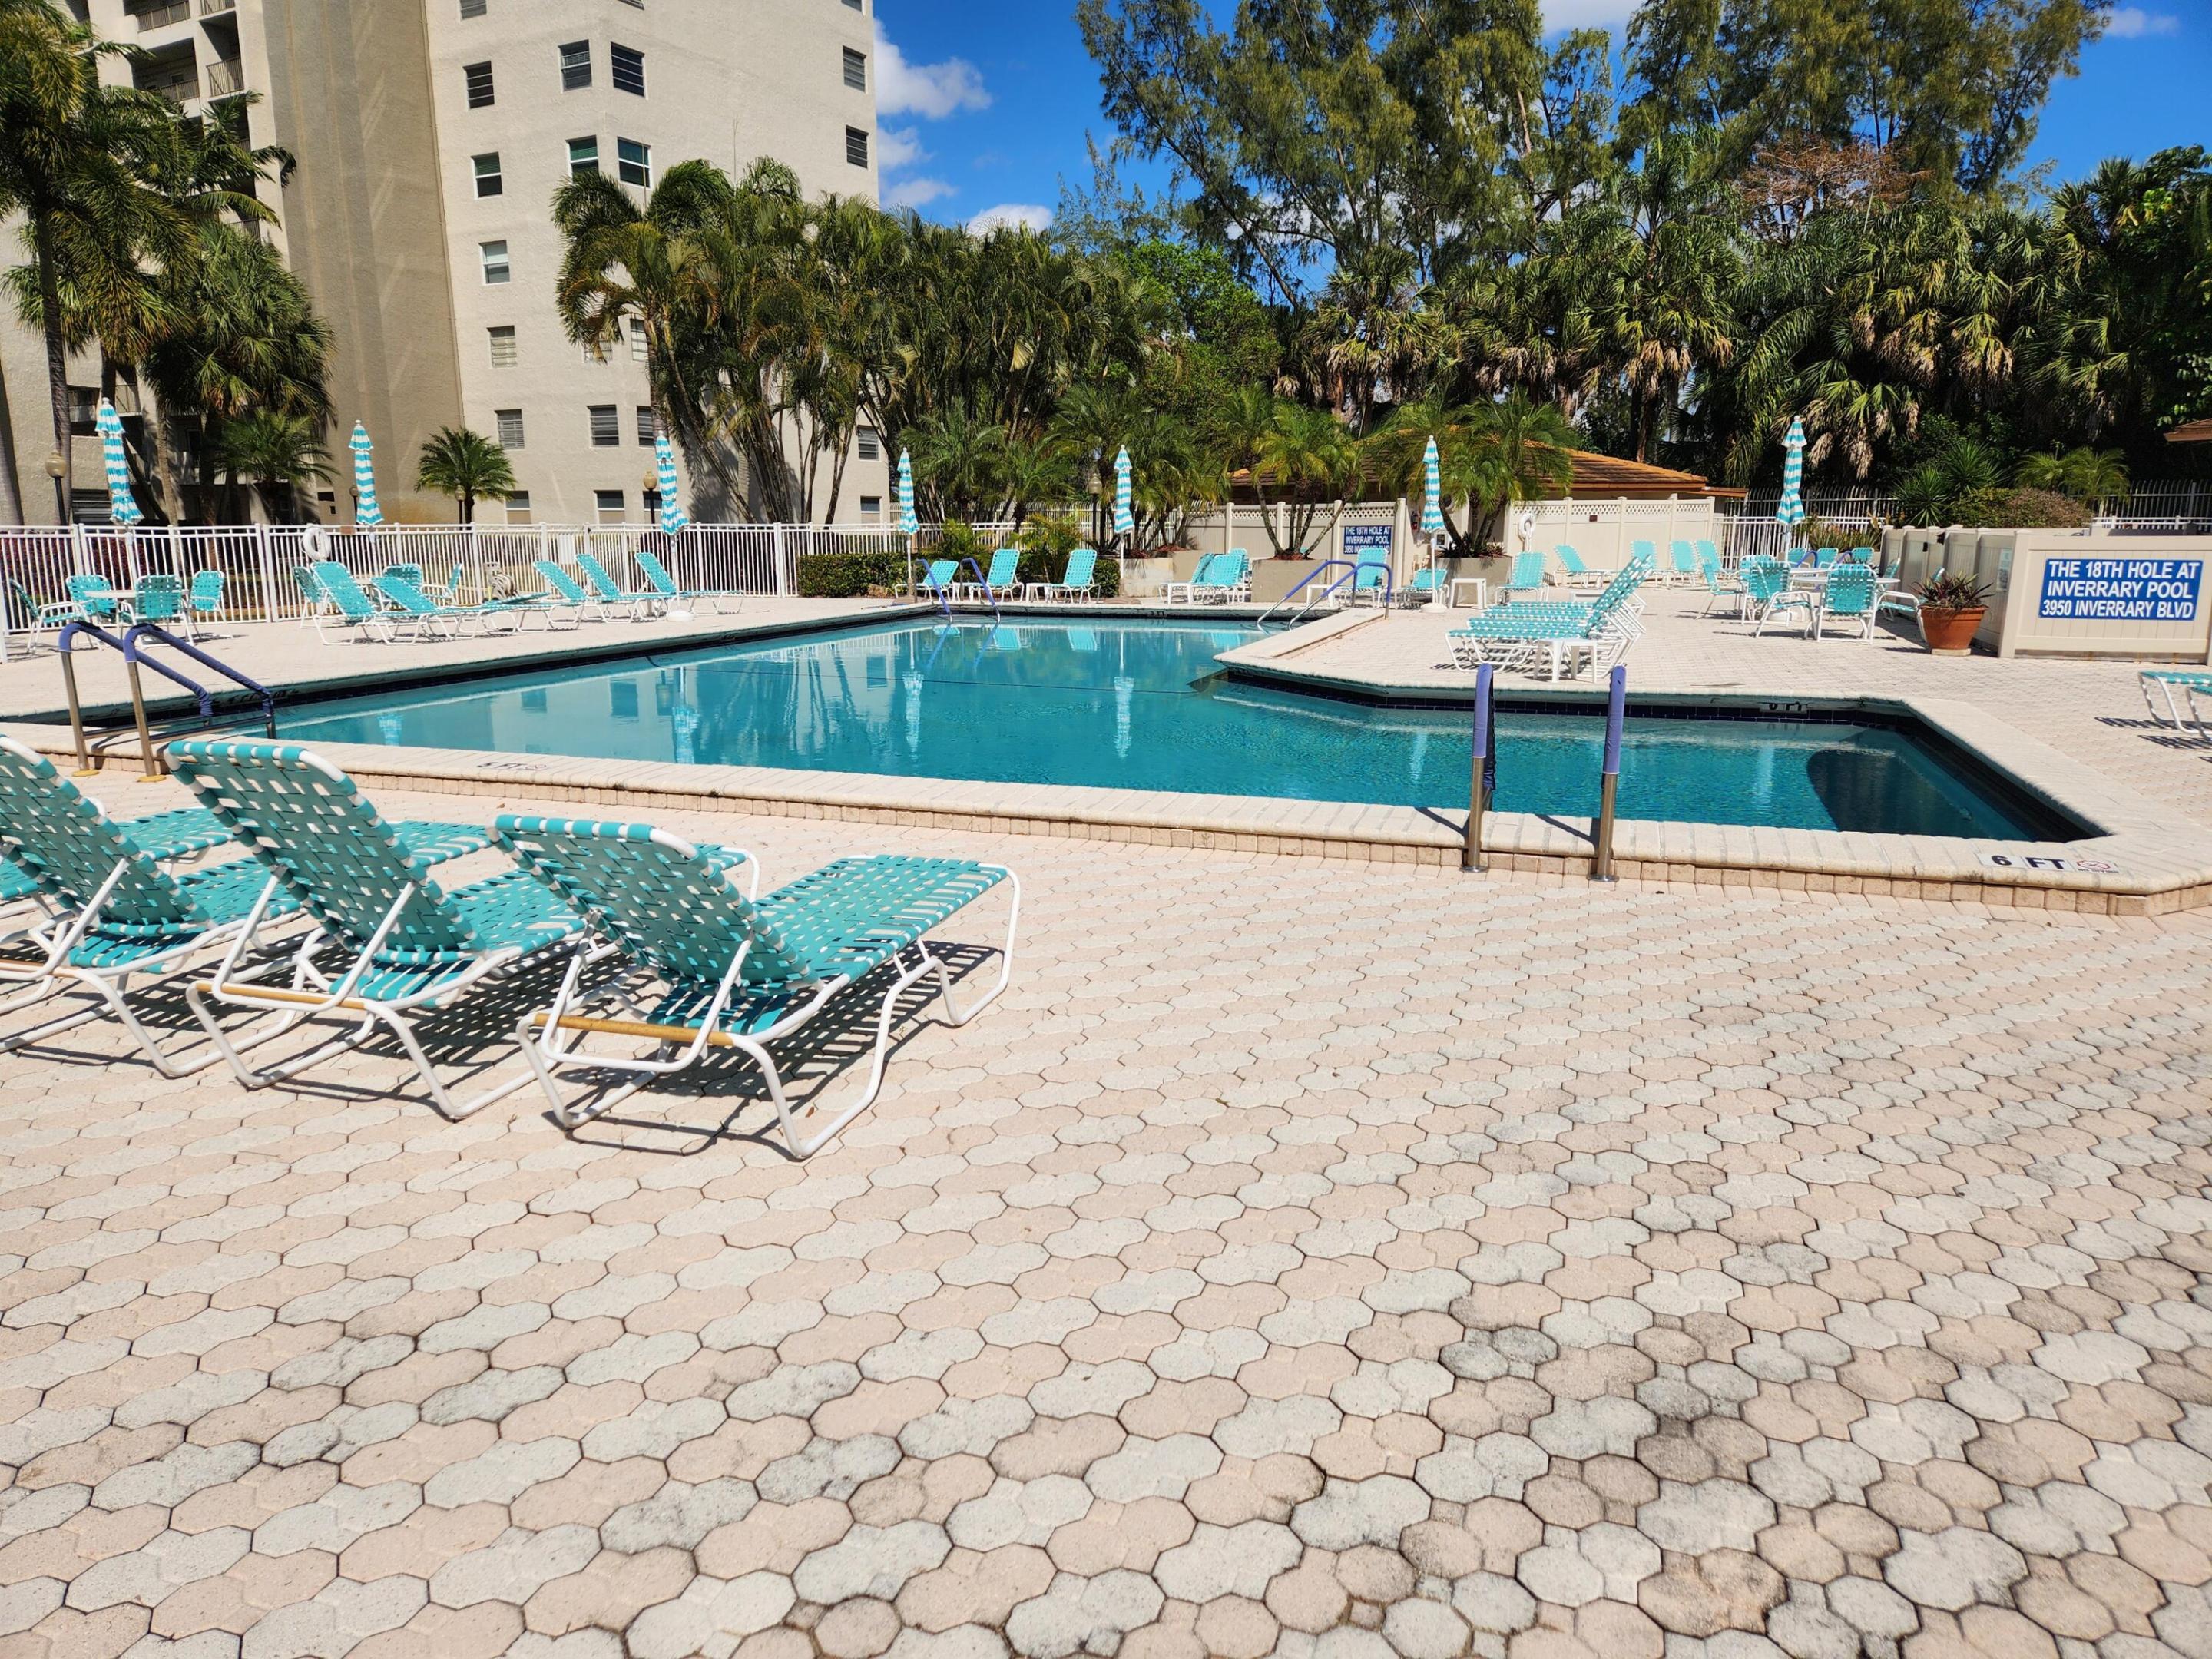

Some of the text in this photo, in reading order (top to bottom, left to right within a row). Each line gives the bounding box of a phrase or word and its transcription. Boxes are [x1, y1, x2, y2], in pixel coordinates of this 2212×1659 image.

[2048, 561, 2199, 578] THE 18TH HOLE AT
[2047, 581, 2193, 598] INVERRARY POOL
[2041, 600, 2194, 618] 3950 INVERRARY BLVD
[1991, 855, 2065, 869] 6 FT
